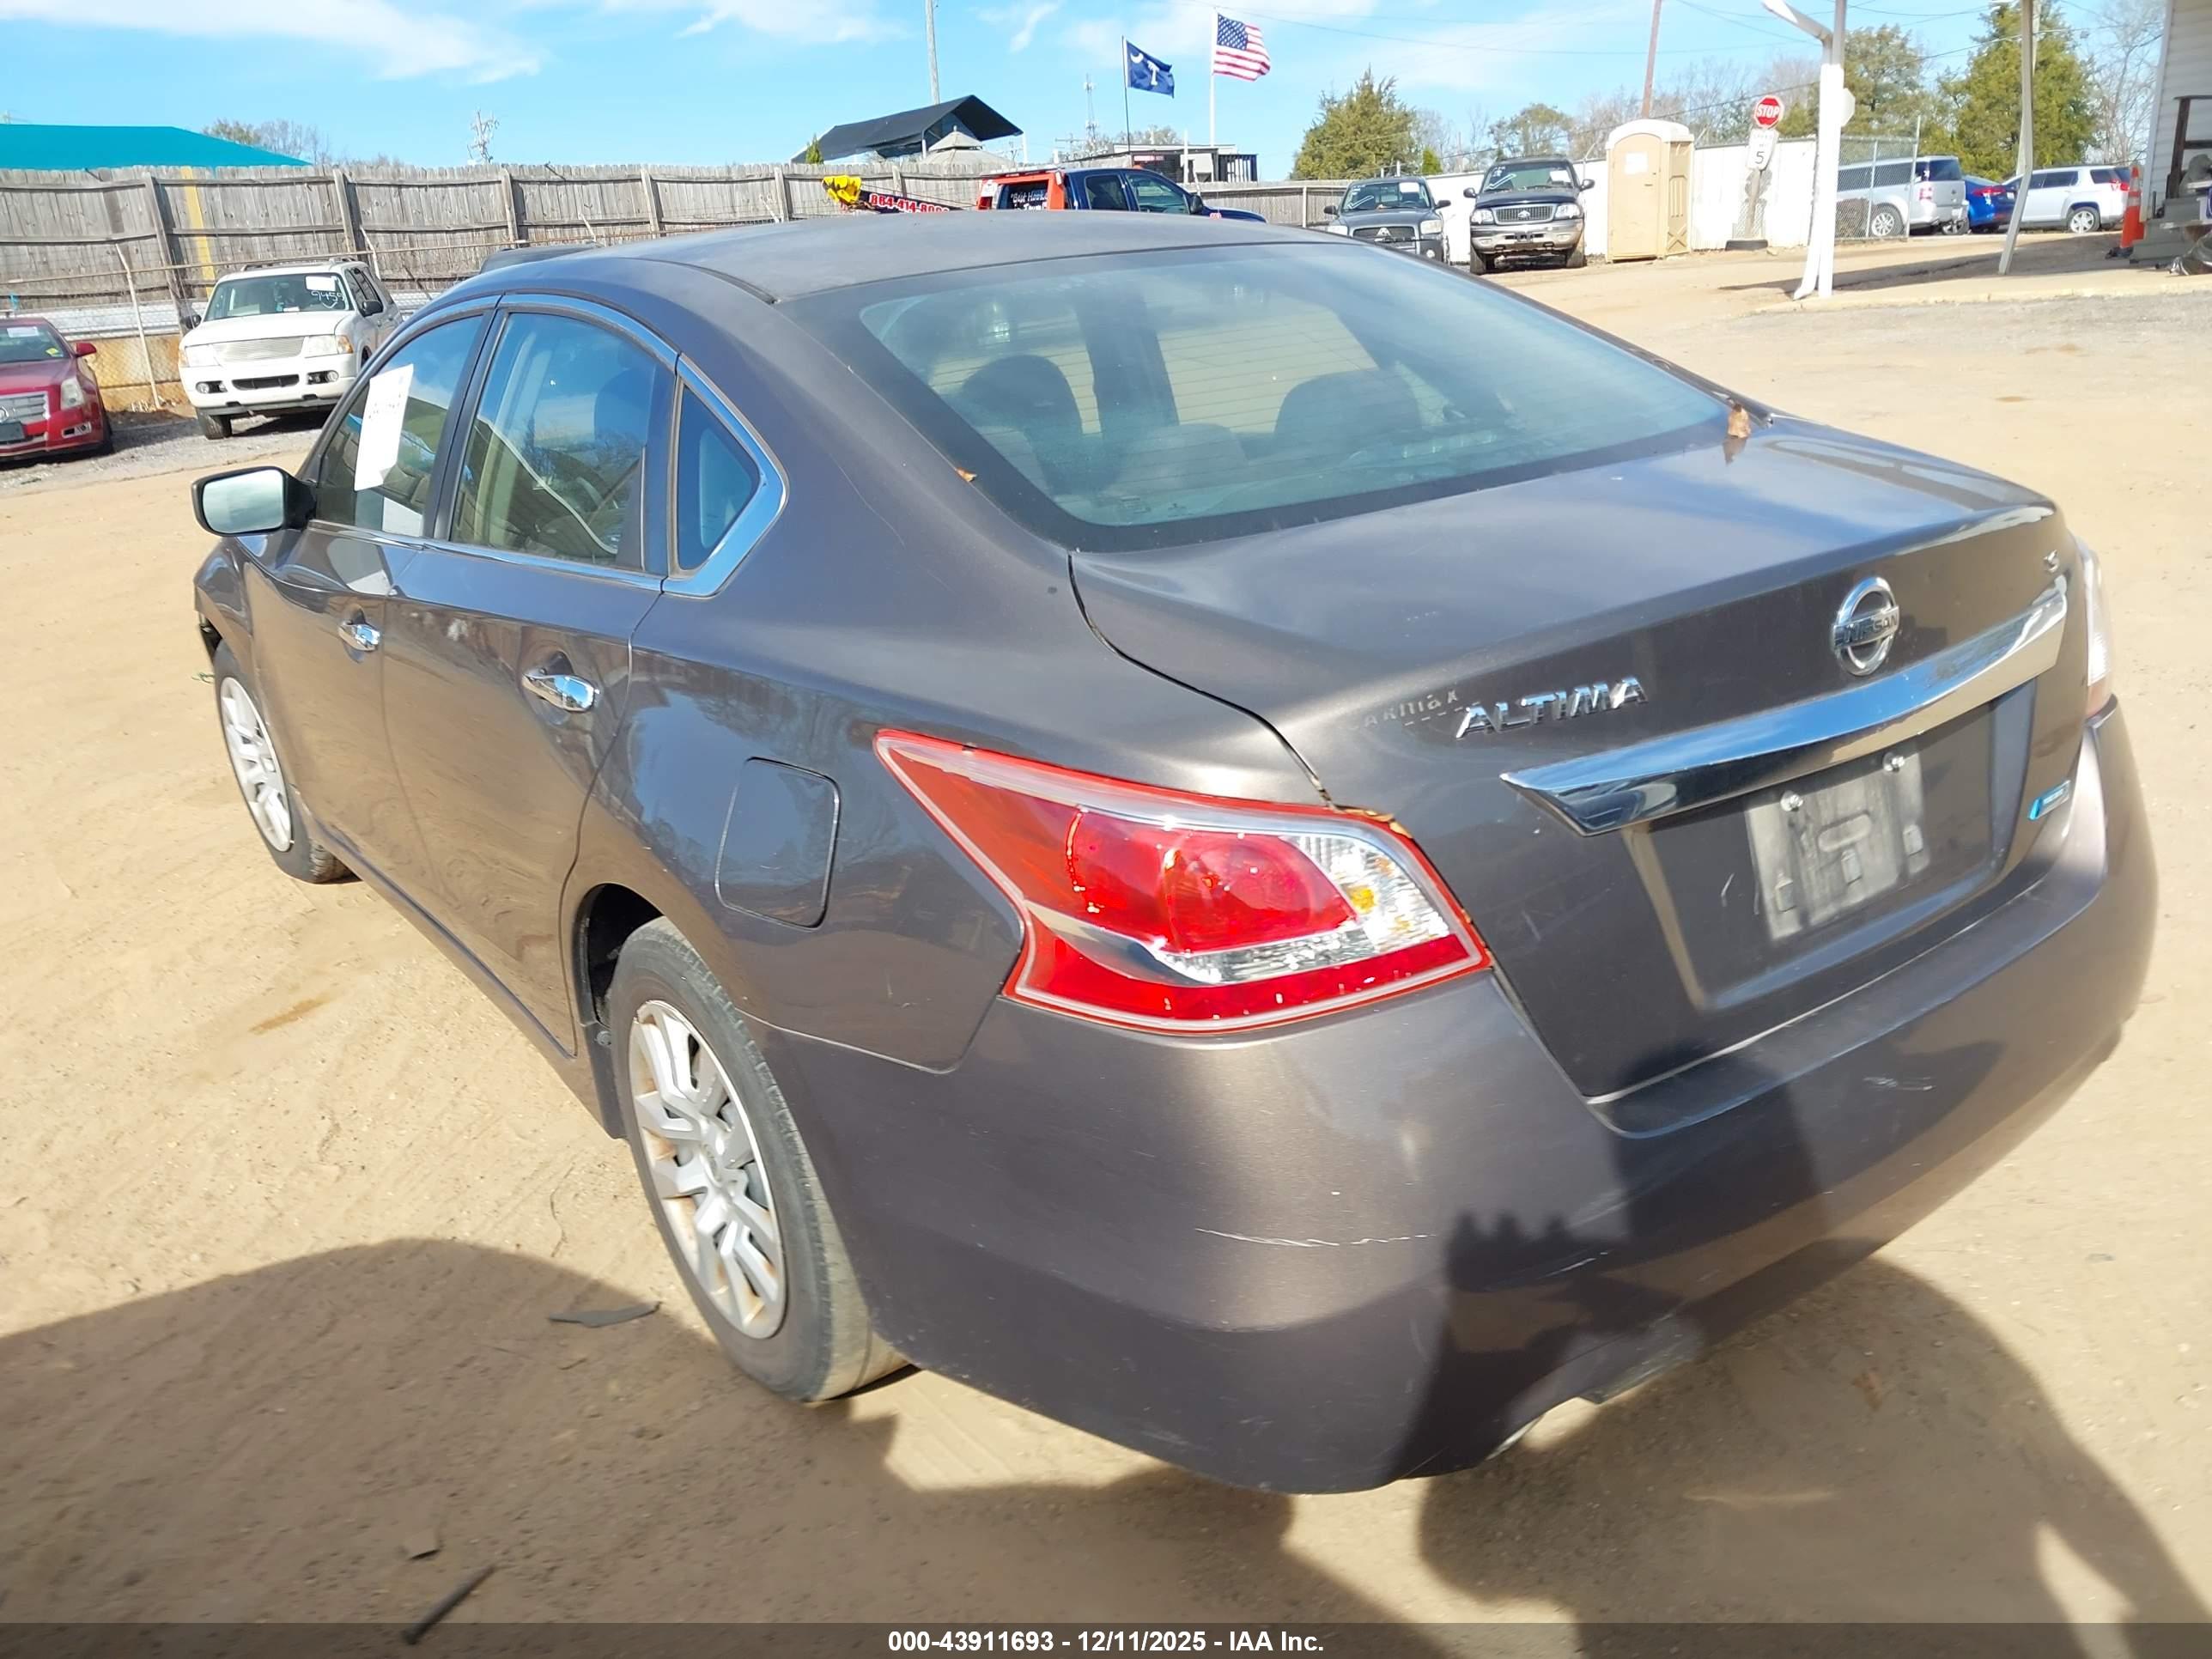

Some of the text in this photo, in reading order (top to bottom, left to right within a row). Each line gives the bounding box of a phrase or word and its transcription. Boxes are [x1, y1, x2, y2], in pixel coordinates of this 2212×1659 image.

[1757, 104, 1780, 118] STOP
[1754, 150, 1765, 164] 5
[1843, 614, 1898, 644] NISSAN
[1455, 677, 1650, 740] ALTIMA
